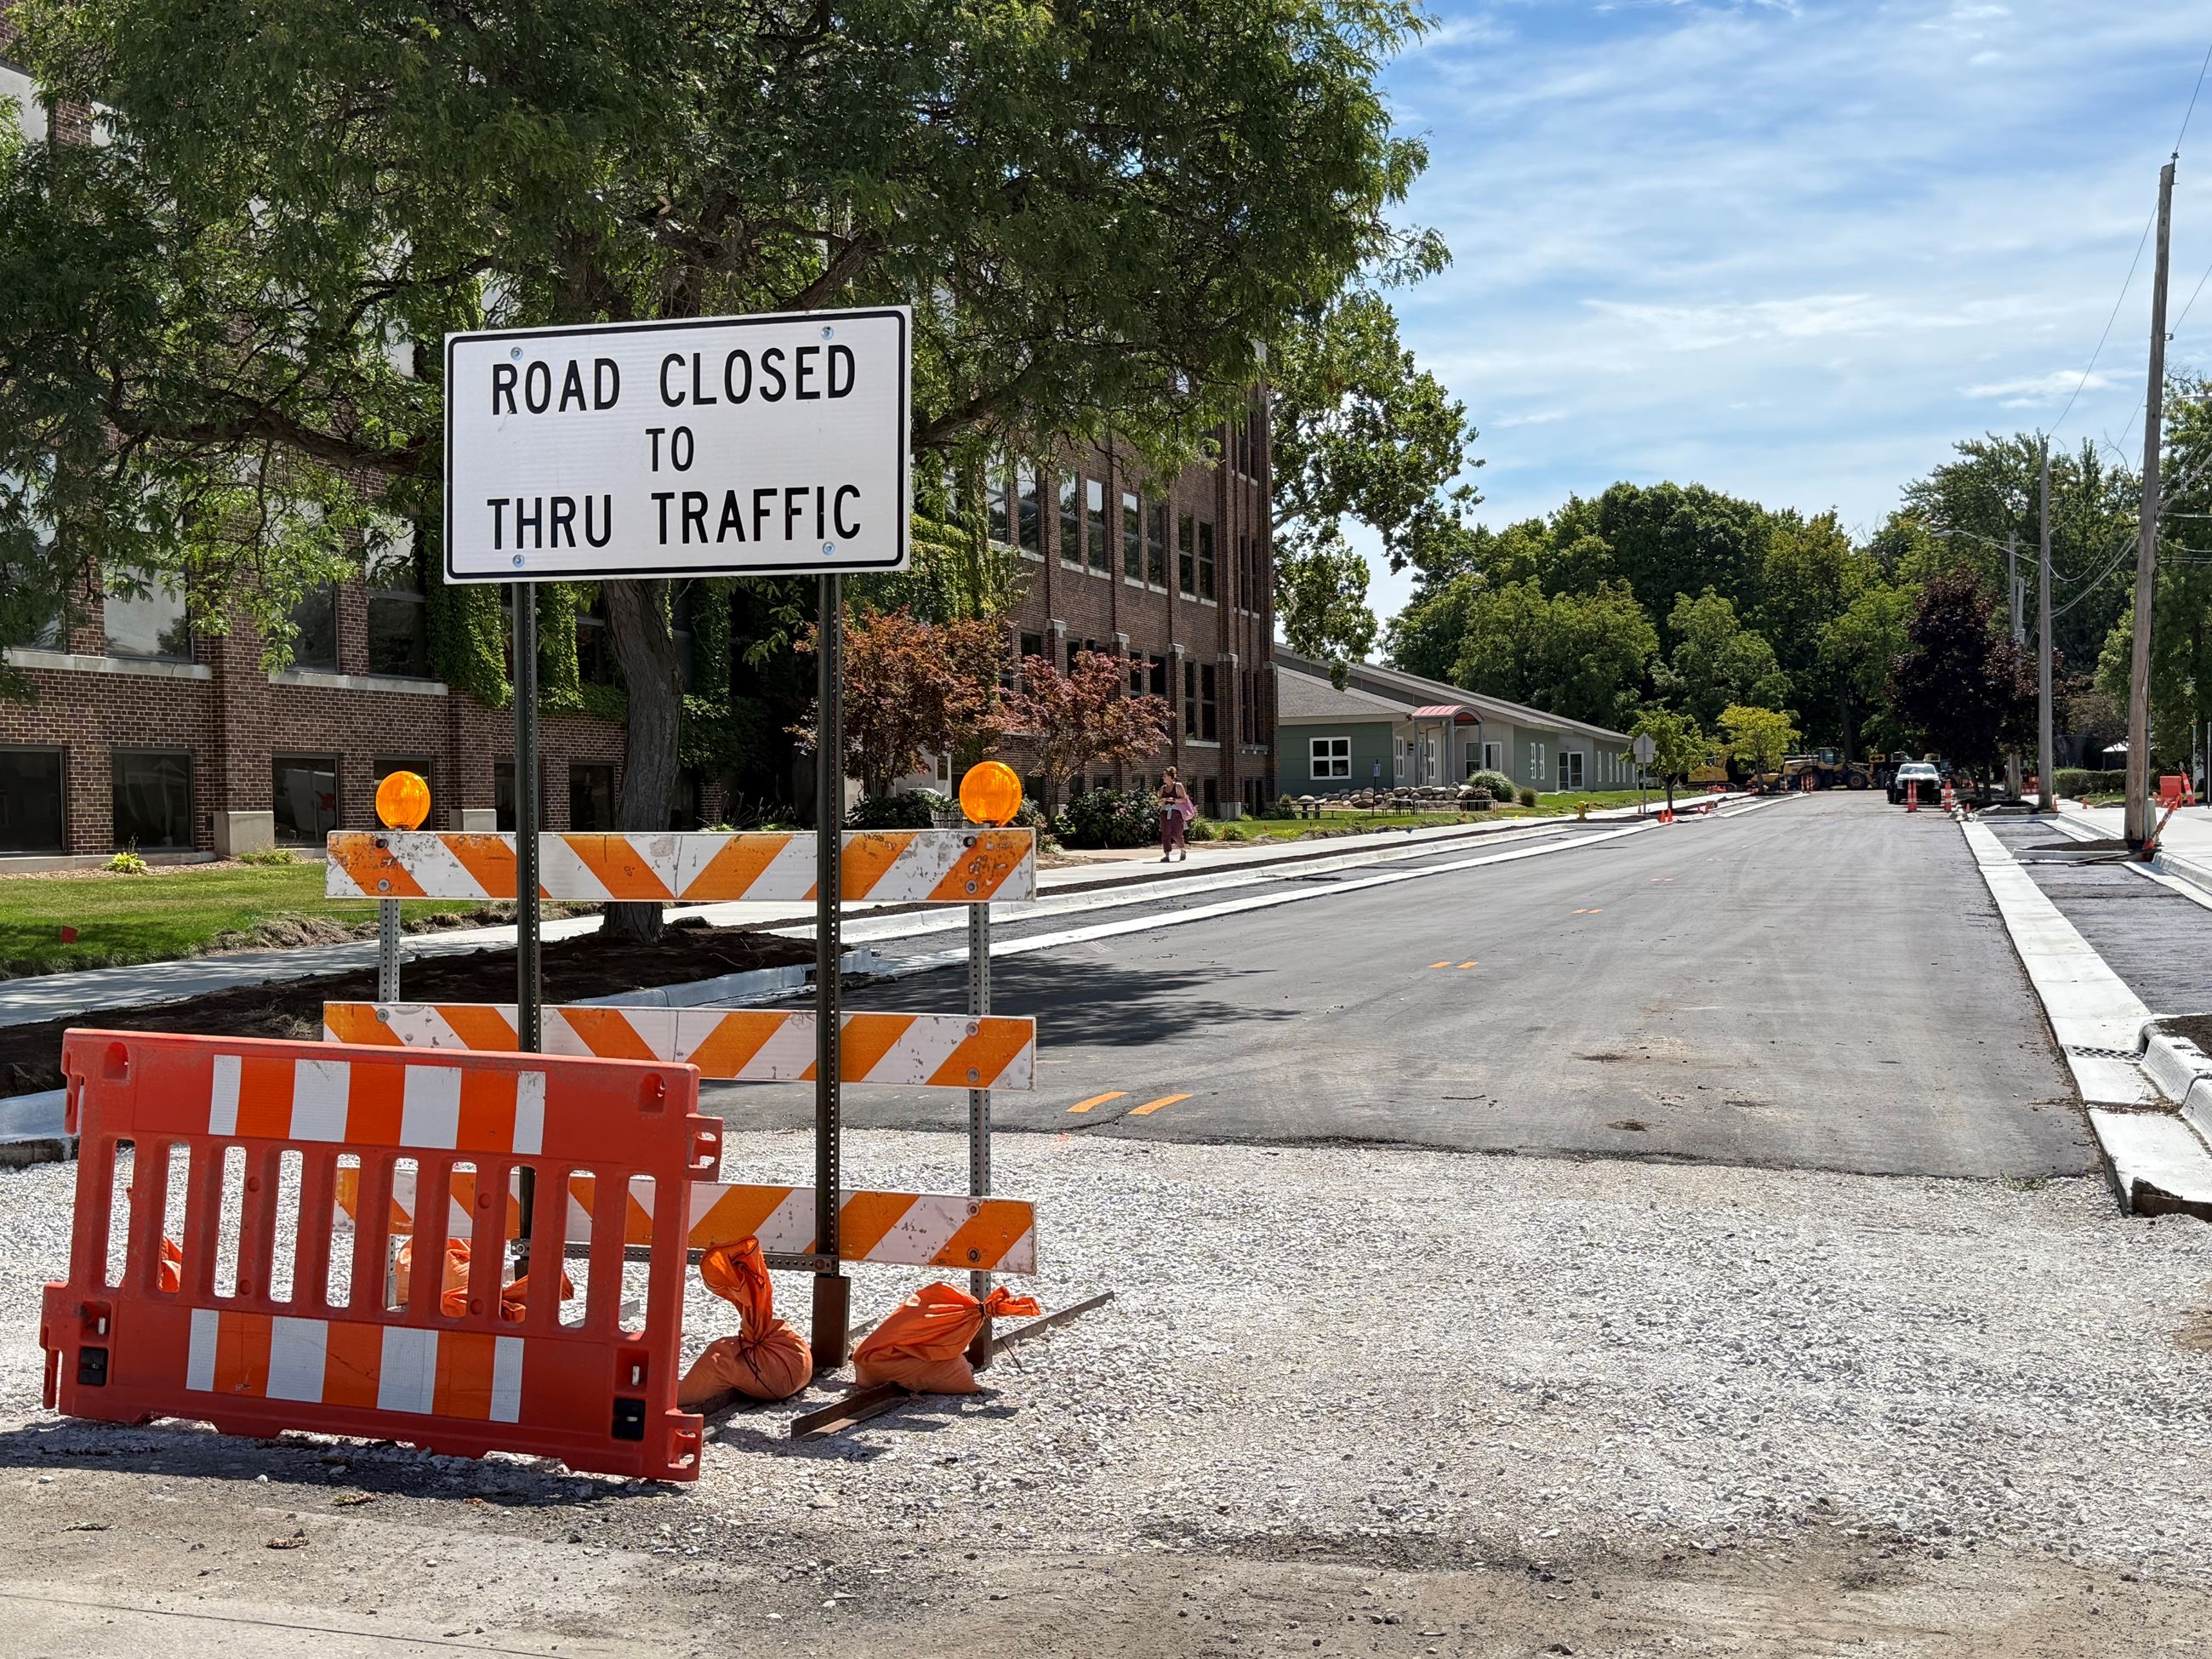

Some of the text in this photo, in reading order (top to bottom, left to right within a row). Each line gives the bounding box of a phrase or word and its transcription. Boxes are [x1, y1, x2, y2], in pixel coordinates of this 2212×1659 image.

[492, 345, 856, 416] ROAD CLOSED
[646, 426, 694, 472] TO
[487, 484, 861, 550] THRU TRAFFIC
